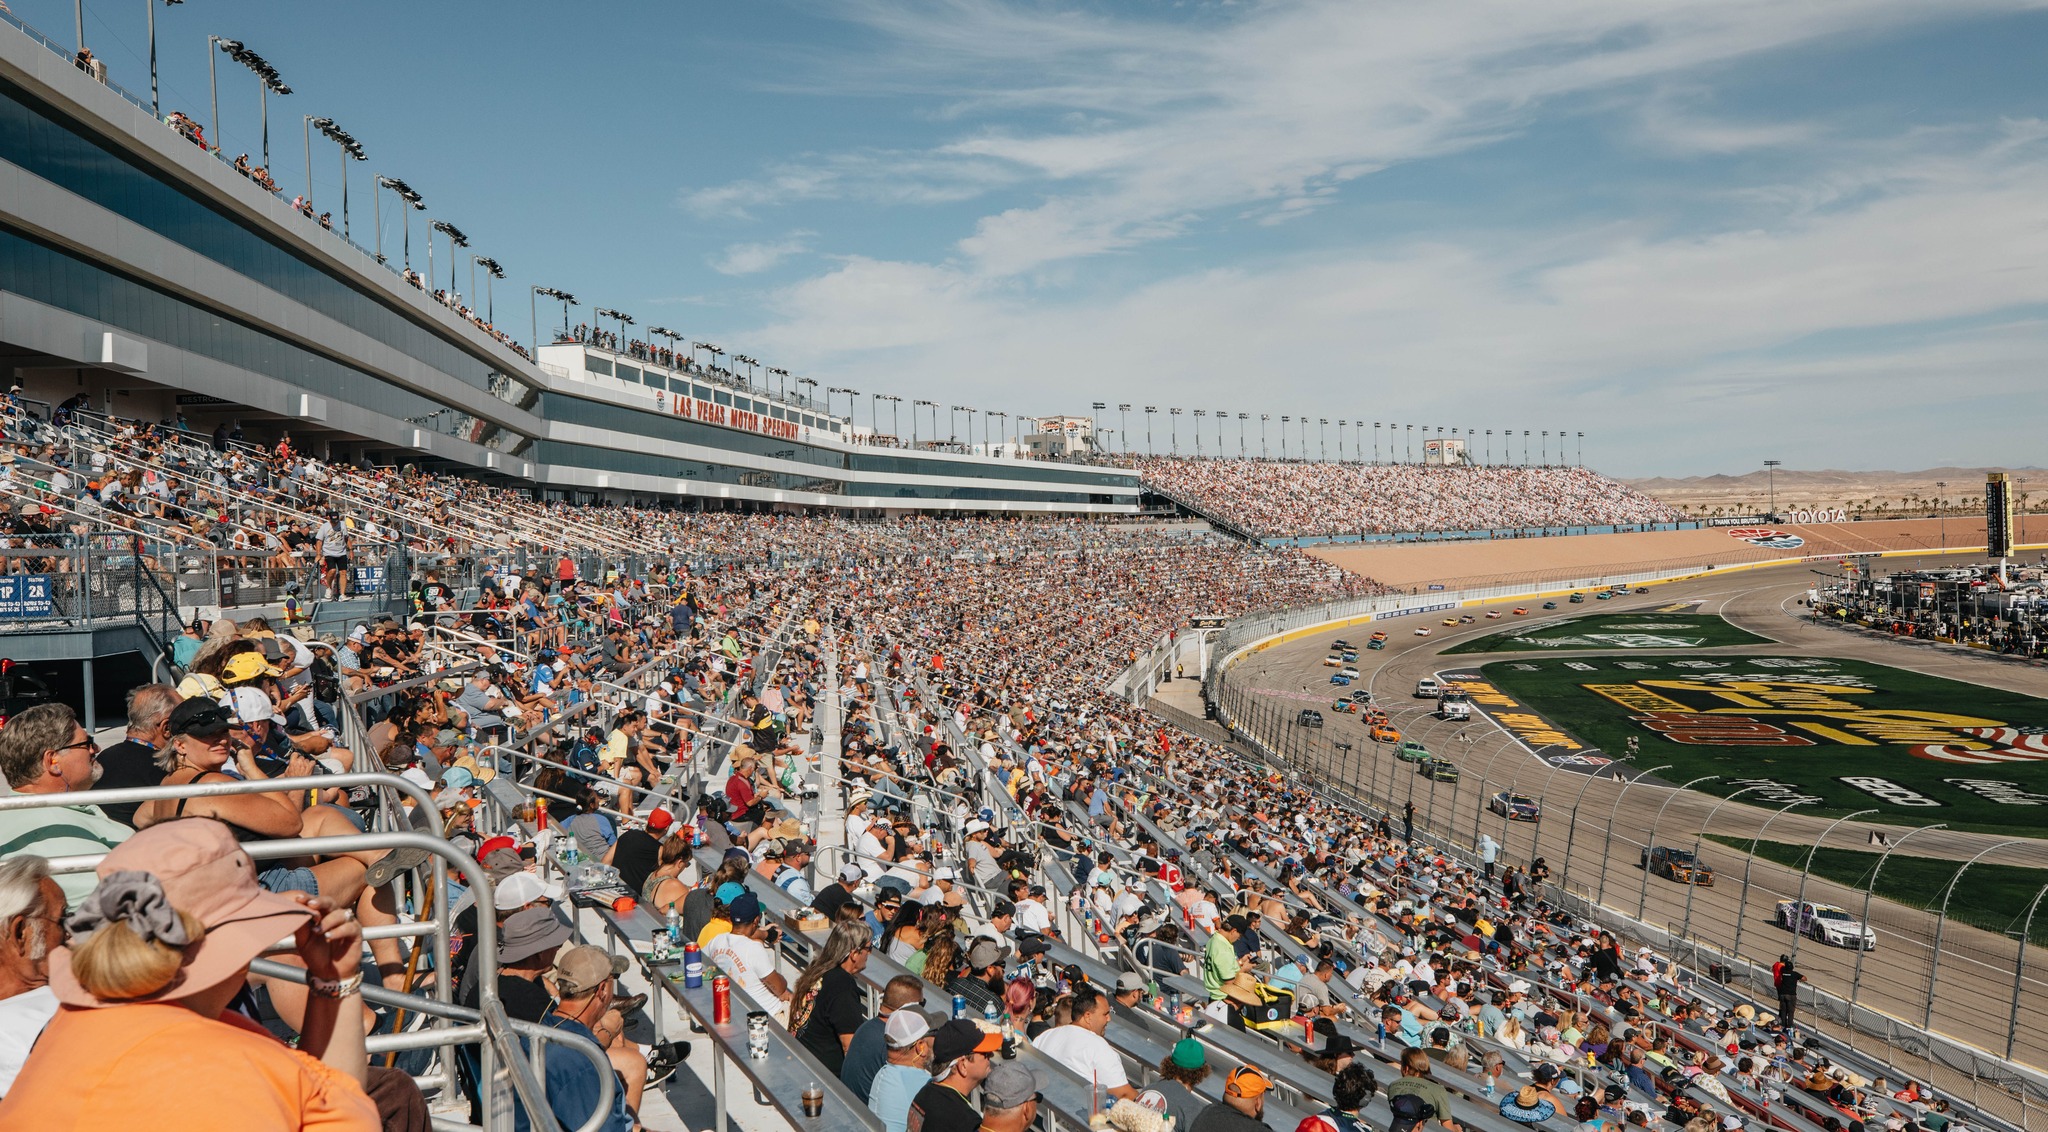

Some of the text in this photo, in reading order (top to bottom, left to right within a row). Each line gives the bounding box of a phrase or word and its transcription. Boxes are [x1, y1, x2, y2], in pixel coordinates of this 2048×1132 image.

[673, 393, 799, 440] LAS VEGAS MOTOR SPEEDWAY
[1788, 508, 1847, 524] TOYOTA
[29, 586, 44, 597] 2A
[1628, 711, 1818, 746] 400
[1838, 775, 1943, 807] GEICO
